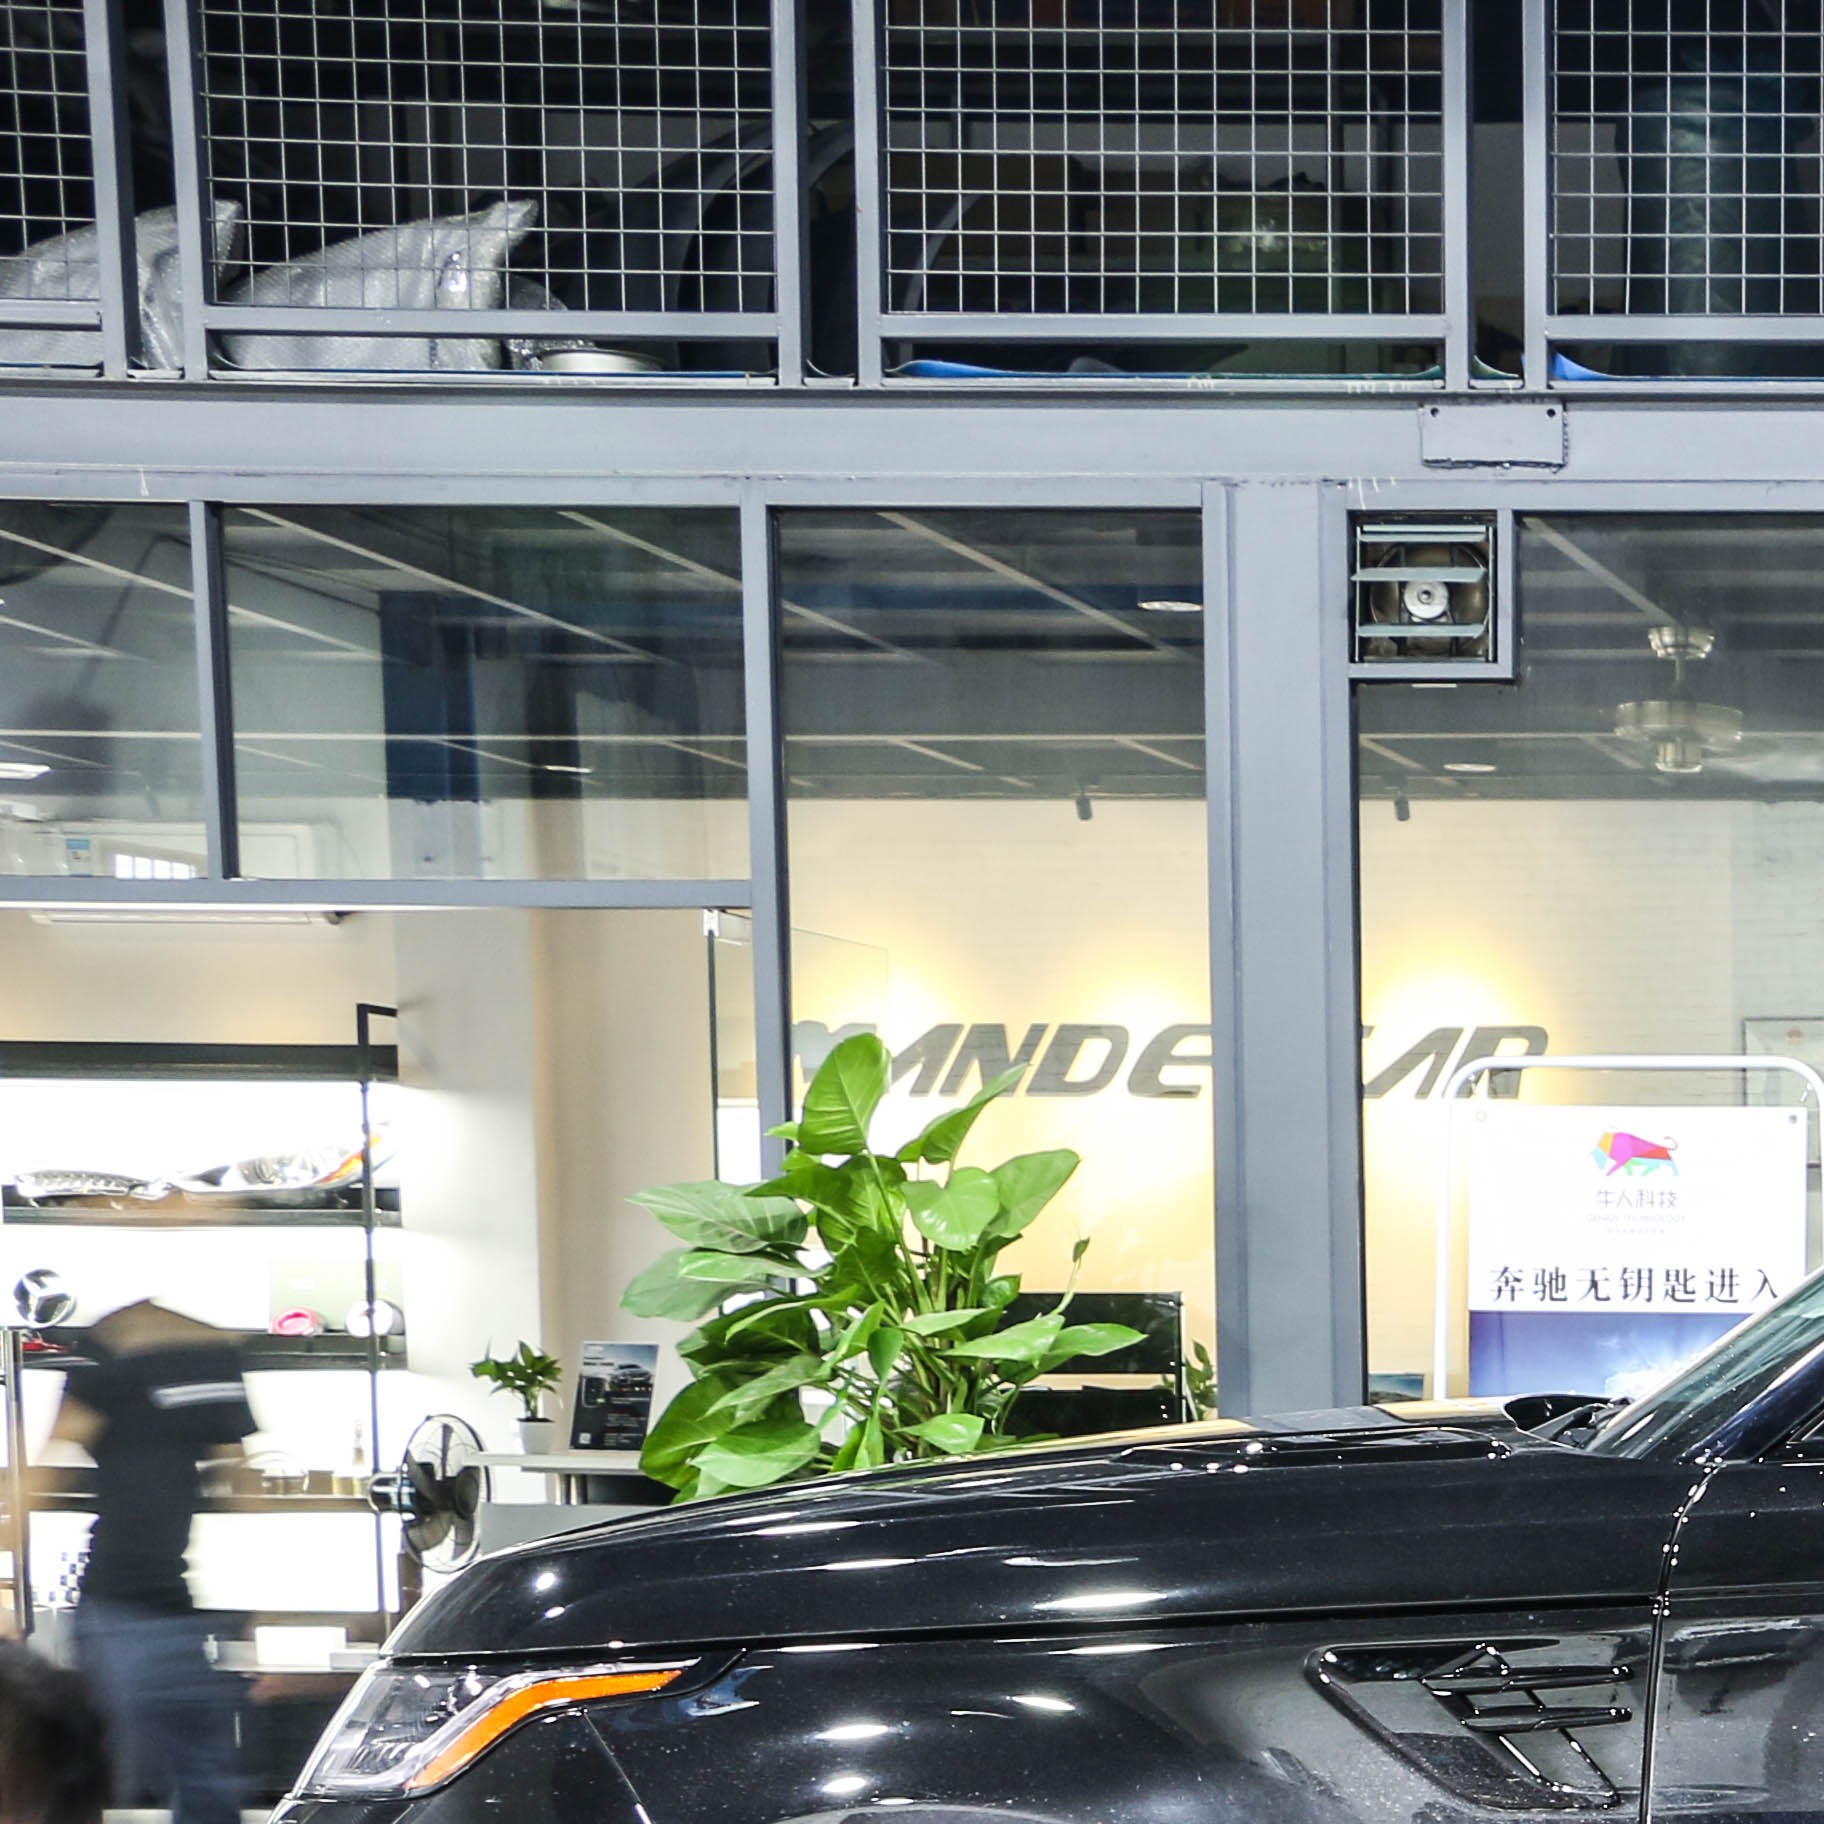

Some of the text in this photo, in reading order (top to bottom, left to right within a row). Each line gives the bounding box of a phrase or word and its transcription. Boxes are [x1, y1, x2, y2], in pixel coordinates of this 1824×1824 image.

[1596, 1189, 1678, 1208] 牛人科技
[1489, 1265, 1779, 1303] 奔驰无钥匙进入
